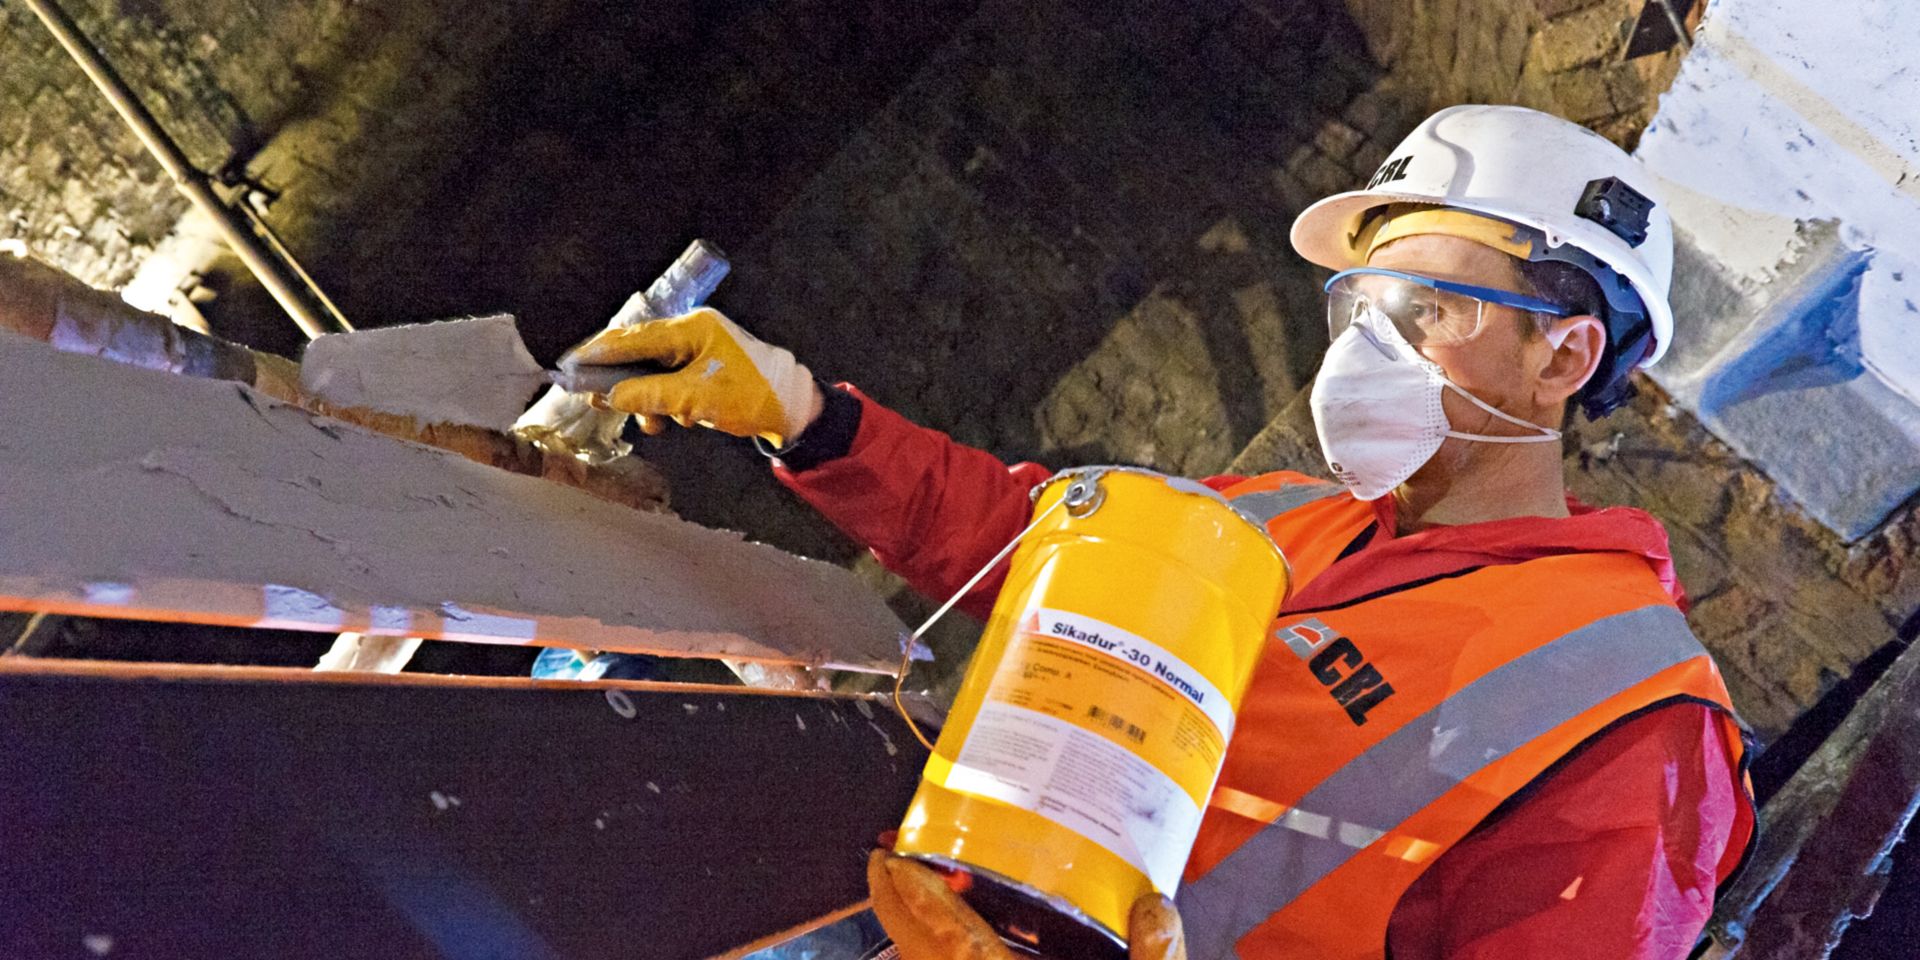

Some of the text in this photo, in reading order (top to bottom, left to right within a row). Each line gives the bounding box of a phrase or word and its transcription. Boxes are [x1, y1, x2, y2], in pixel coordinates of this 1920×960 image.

[1366, 155, 1415, 191] CRL
[1154, 661, 1205, 704] Normal
[1308, 636, 1396, 727] CRL
